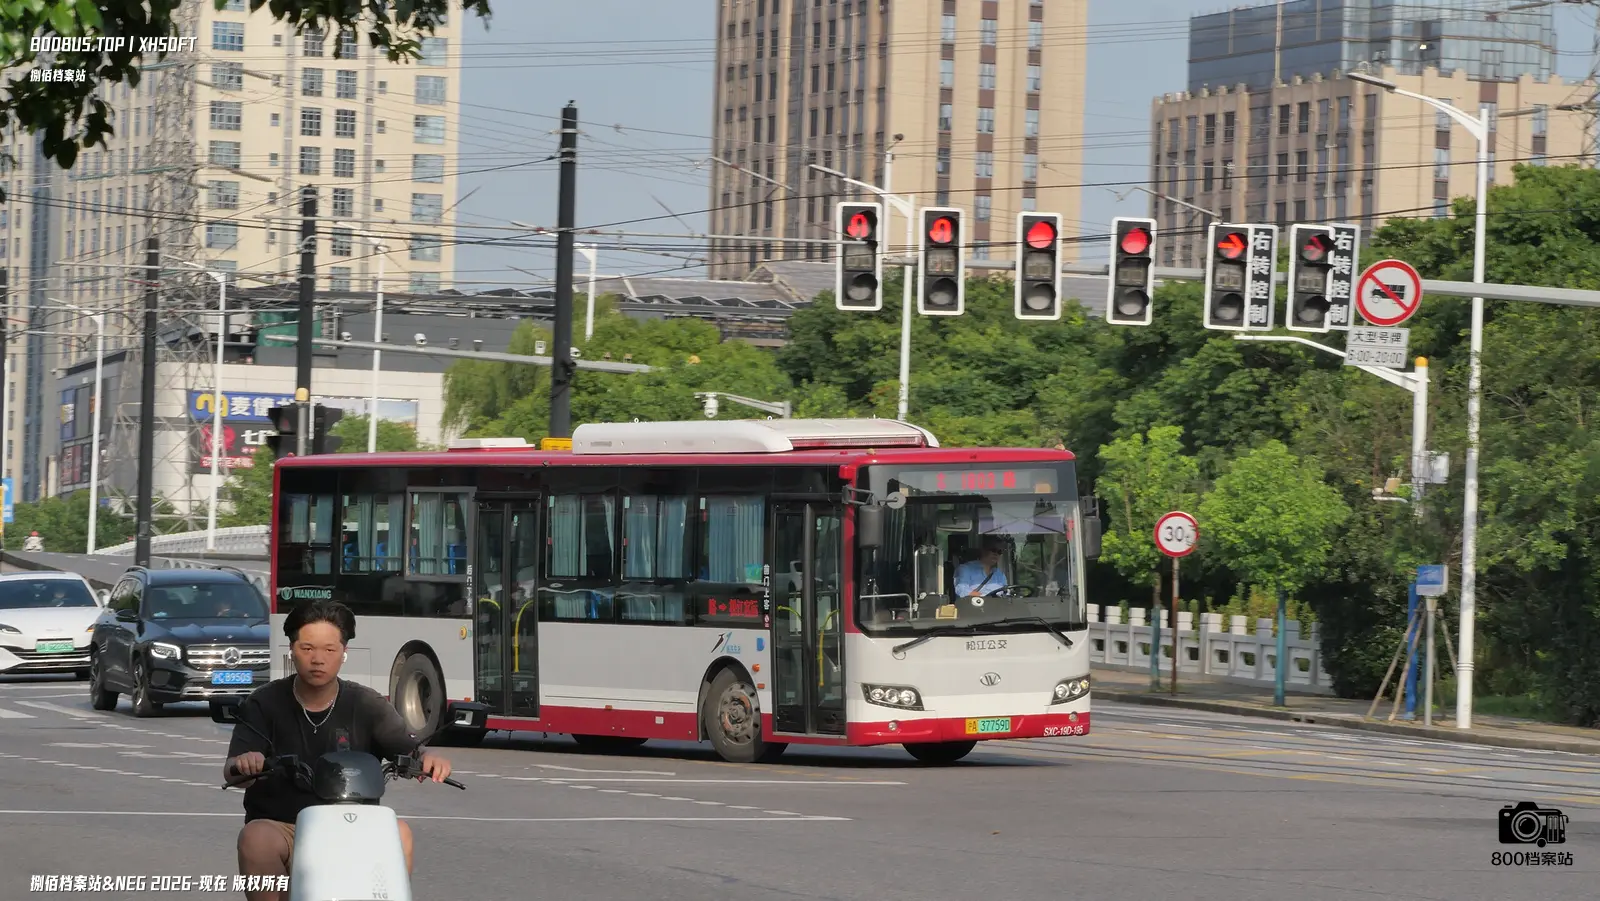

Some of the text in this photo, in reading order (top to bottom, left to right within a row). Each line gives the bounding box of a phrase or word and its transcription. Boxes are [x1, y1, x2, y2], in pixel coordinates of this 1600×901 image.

[1249, 231, 1273, 324] 右转控制
[1329, 231, 1354, 324] 右转控制
[1352, 330, 1403, 345] 大型号牌
[293, 588, 332, 600] WANXIANG
